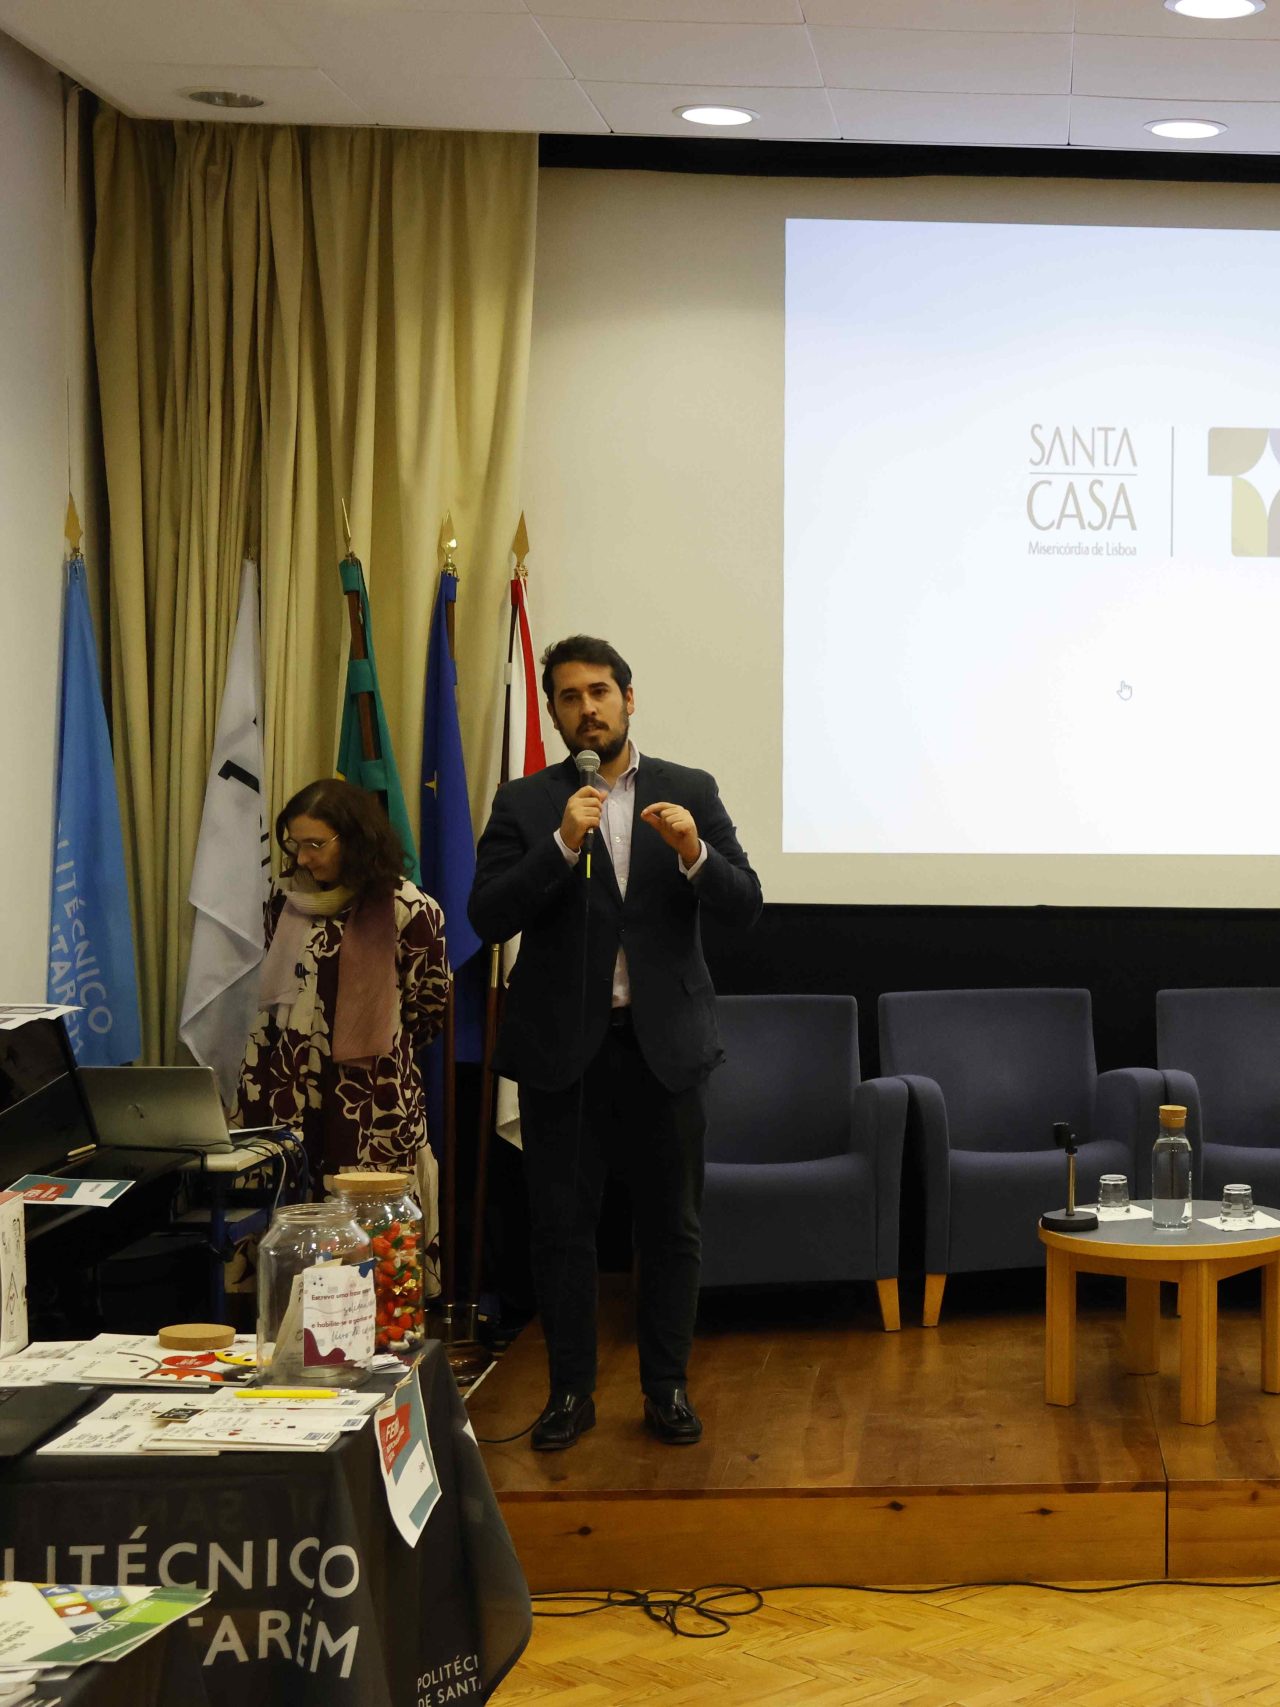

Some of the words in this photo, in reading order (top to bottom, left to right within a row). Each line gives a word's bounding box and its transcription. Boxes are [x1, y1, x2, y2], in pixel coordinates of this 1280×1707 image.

[1029, 424, 1137, 468] SANTA
[1027, 479, 1137, 531] CASA
[1028, 540, 1089, 555] Misericórdia
[1091, 542, 1103, 556] de
[1106, 542, 1136, 556] Lisboa
[187, 1598, 359, 1678] ARÉM
[437, 1676, 482, 1704] SANT
